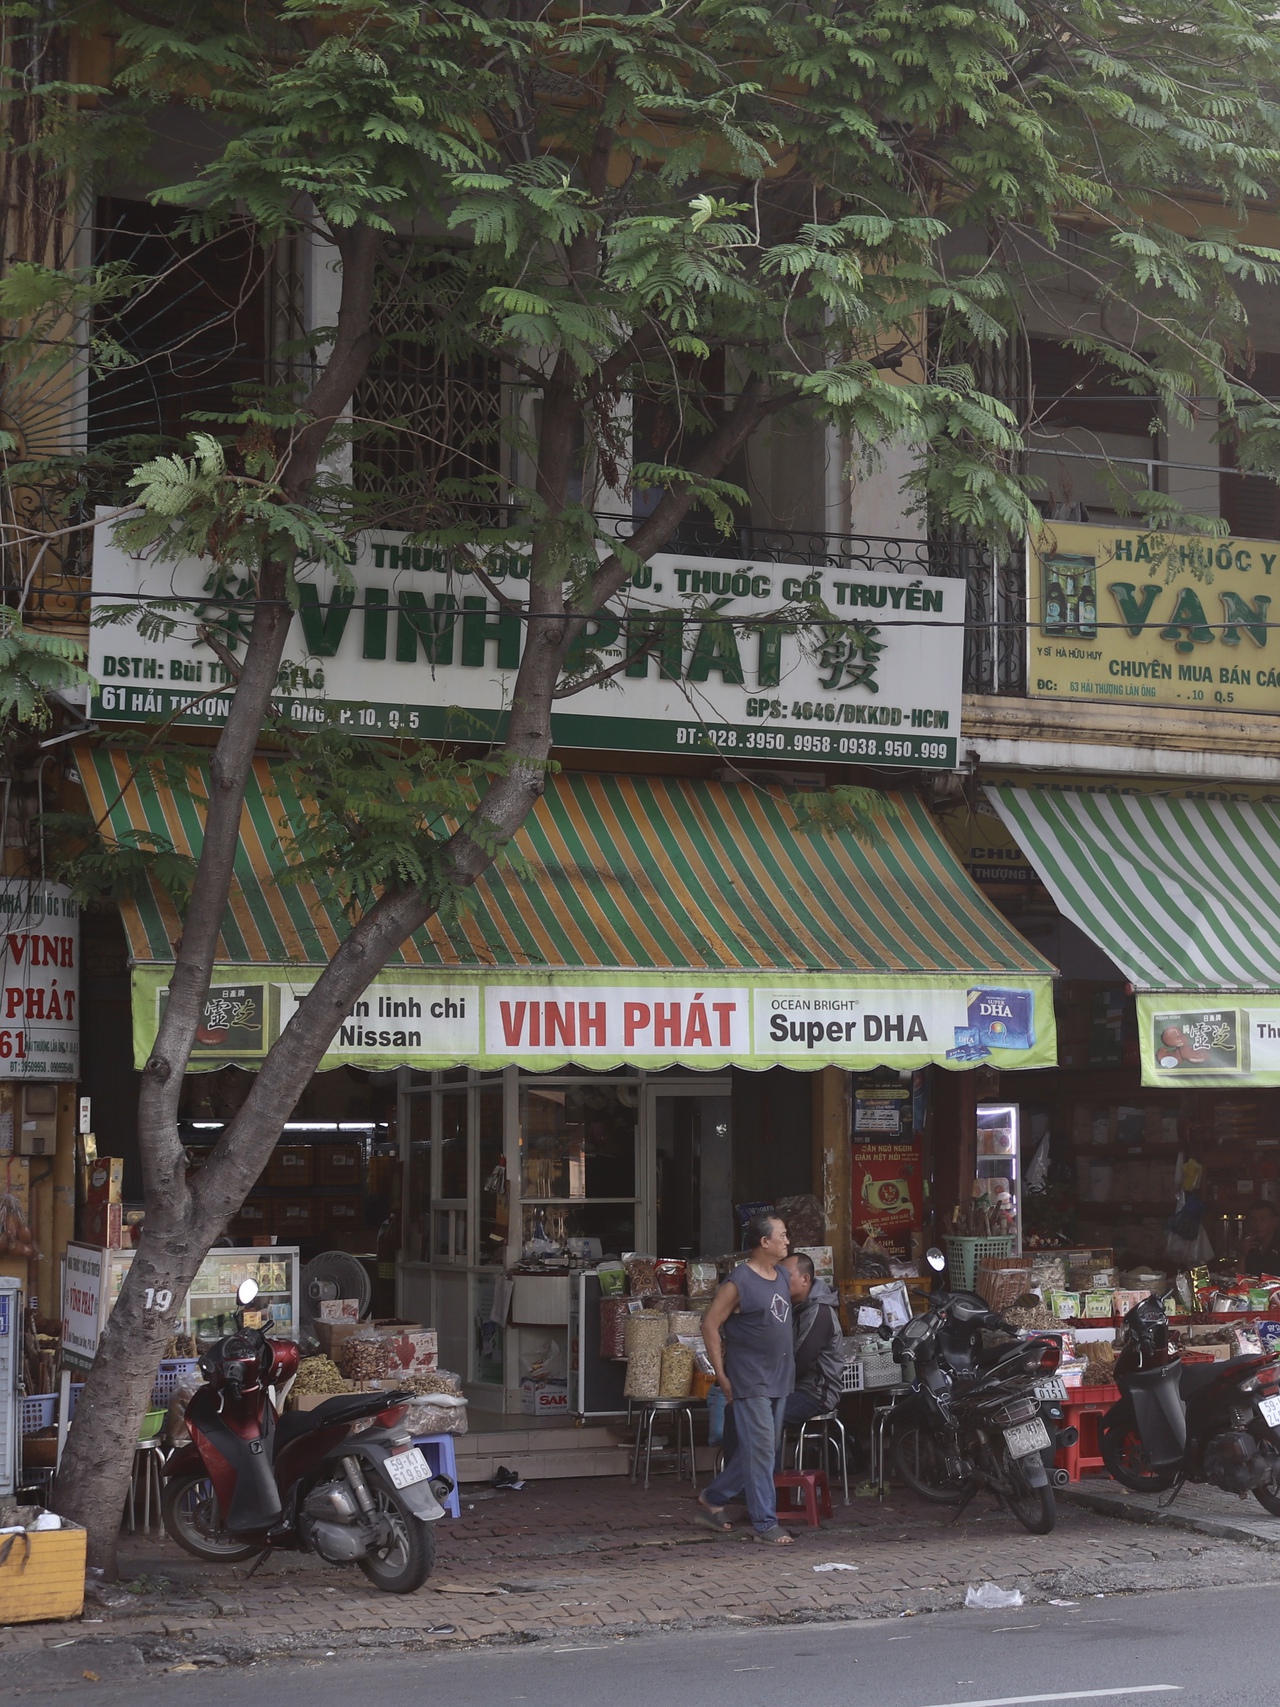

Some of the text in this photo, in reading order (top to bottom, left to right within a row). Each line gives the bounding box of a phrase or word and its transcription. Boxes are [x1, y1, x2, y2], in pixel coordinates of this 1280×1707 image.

[1260, 553, 1277, 575] Y
[674, 566, 771, 599] THUỐC
[782, 571, 821, 602] CỔ
[833, 580, 943, 612] TRUYỀN
[1107, 582, 1272, 653] VẠN
[297, 583, 798, 687] VINH PHÁT
[1056, 647, 1067, 658] HÀ
[1069, 648, 1085, 660] HỮU
[1087, 650, 1102, 660] HUY
[103, 655, 202, 682] DSTH: Bùi
[1109, 659, 1172, 680] CHUYÊN
[1179, 665, 1213, 683] MUA
[1220, 665, 1251, 686] BÁN
[1037, 679, 1057, 691] ĐC:
[1070, 681, 1079, 692] 63
[1081, 679, 1093, 692] HẢI
[1095, 682, 1124, 697] THƯỢNG
[1141, 684, 1156, 698] ÔNG
[102, 687, 126, 711] 61
[131, 688, 162, 713] HẢI
[169, 695, 233, 722] THƯỢN
[409, 711, 420, 729] 5
[746, 697, 789, 719] GPS:
[676, 727, 703, 745] ĐT:
[7, 934, 74, 967] VINH
[5, 979, 76, 1021] PHÁT
[379, 996, 423, 1018] linh
[430, 996, 466, 1019] chi
[771, 1000, 810, 1011] OCEAN
[980, 1003, 1013, 1018] DHA
[499, 992, 737, 1047] VINH PHÁT
[769, 1014, 928, 1048] Super DHA
[0, 1030, 26, 1058] 61
[339, 1024, 422, 1047] Nissan
[143, 1287, 172, 1312] 19
[1039, 1389, 1064, 1399] 0151
[390, 1452, 418, 1471] 59-K1
[393, 1464, 428, 1486] 519.66
